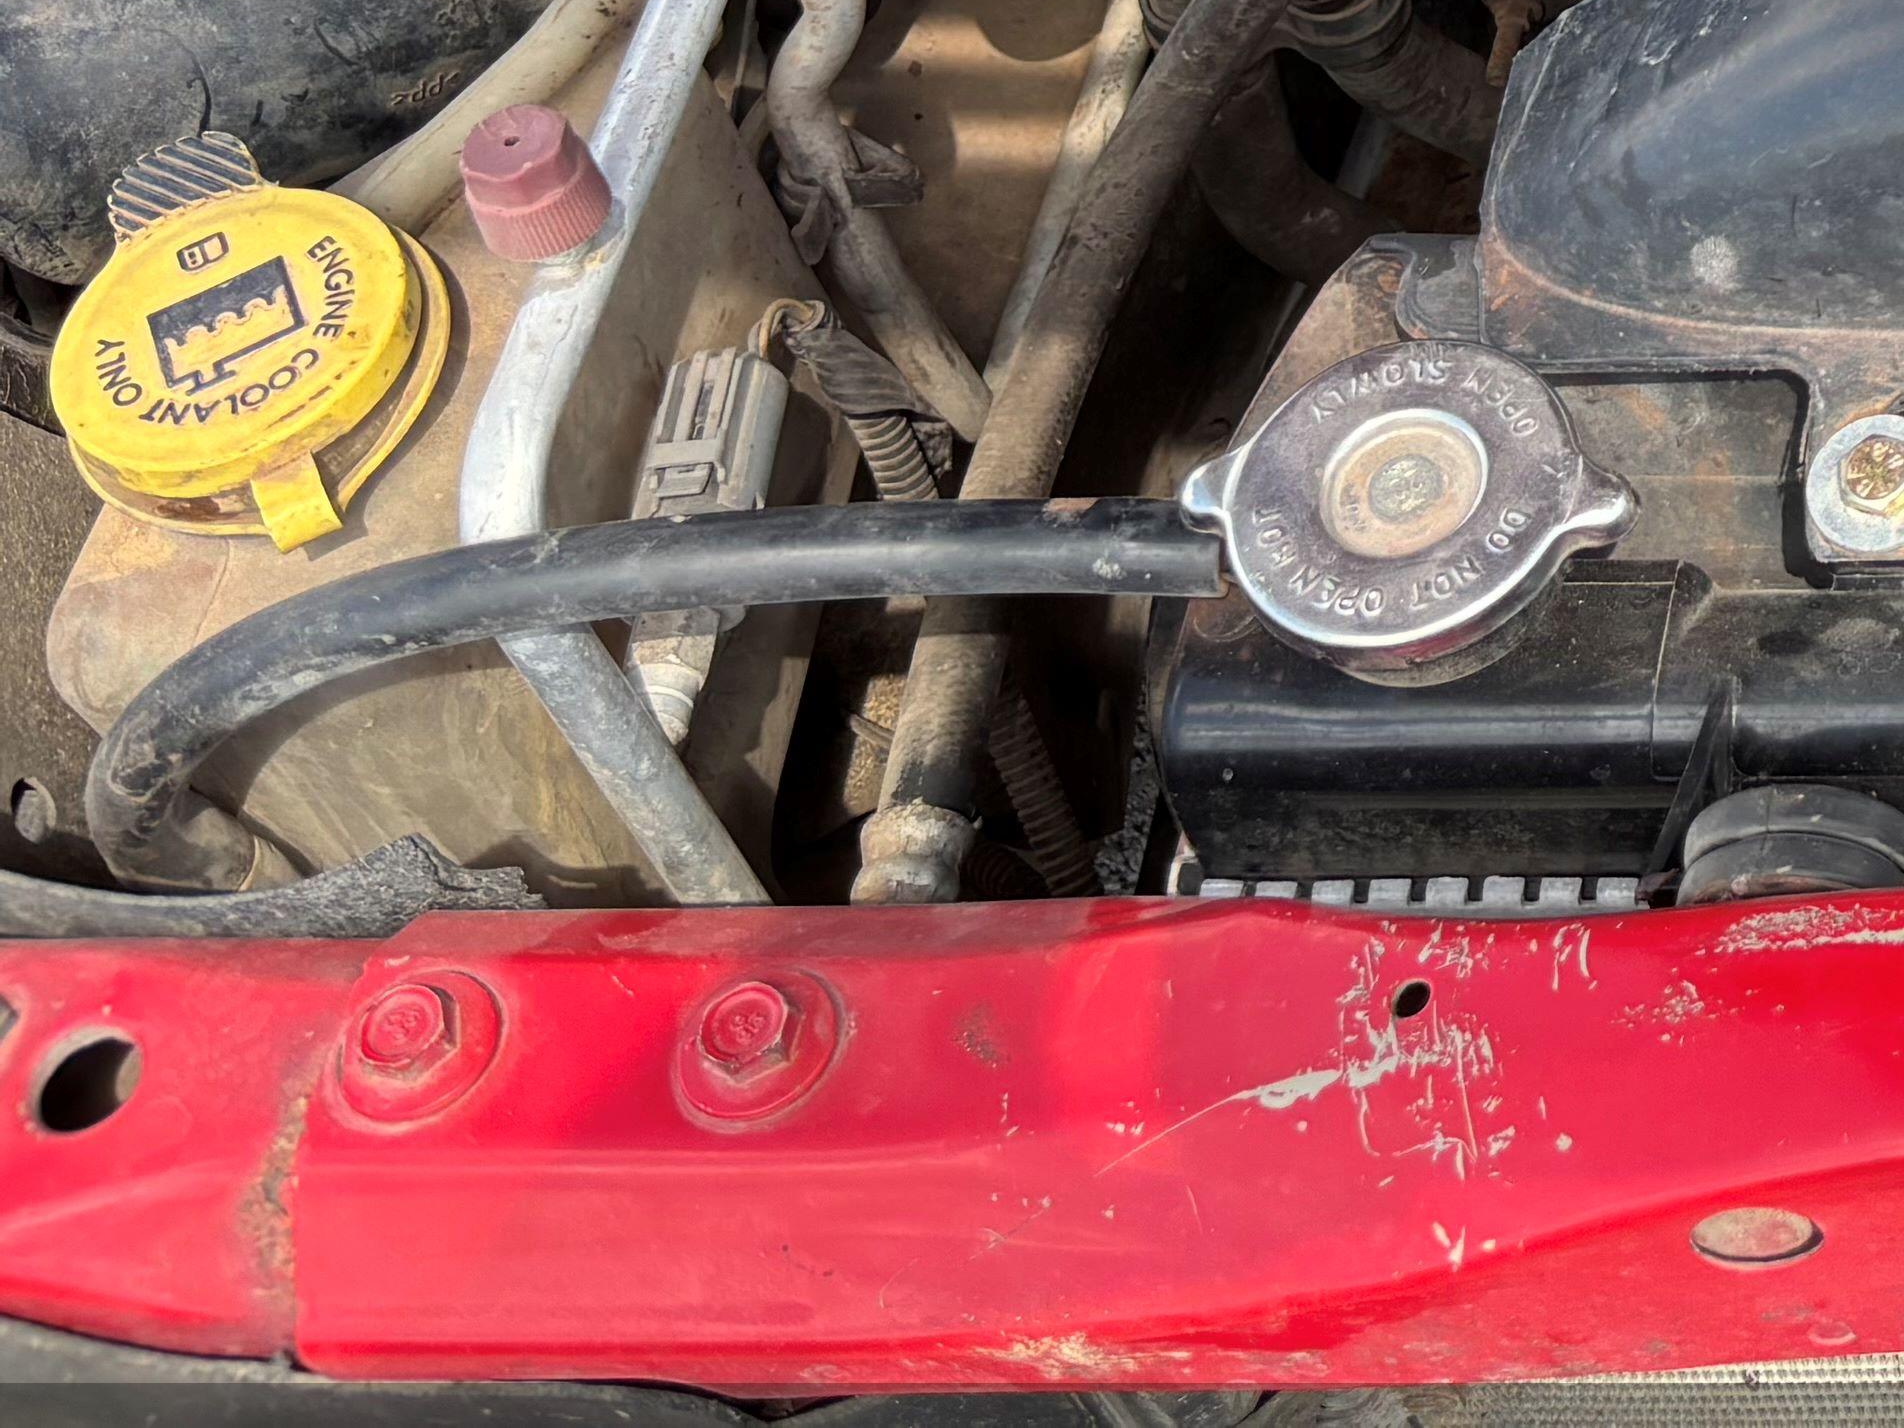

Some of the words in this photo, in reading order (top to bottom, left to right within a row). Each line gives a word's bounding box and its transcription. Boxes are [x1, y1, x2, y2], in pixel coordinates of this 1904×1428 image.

[306, 234, 356, 340] ENGINE
[95, 338, 144, 407] ONLY
[138, 348, 321, 425] COOLANT
[1311, 358, 1456, 425] SLOWLY
[1461, 366, 1541, 437] OPEN
[1253, 507, 1298, 564] HOT
[1485, 507, 1533, 552] DO
[1288, 566, 1386, 619] OPEN
[1412, 554, 1488, 610] NOT
